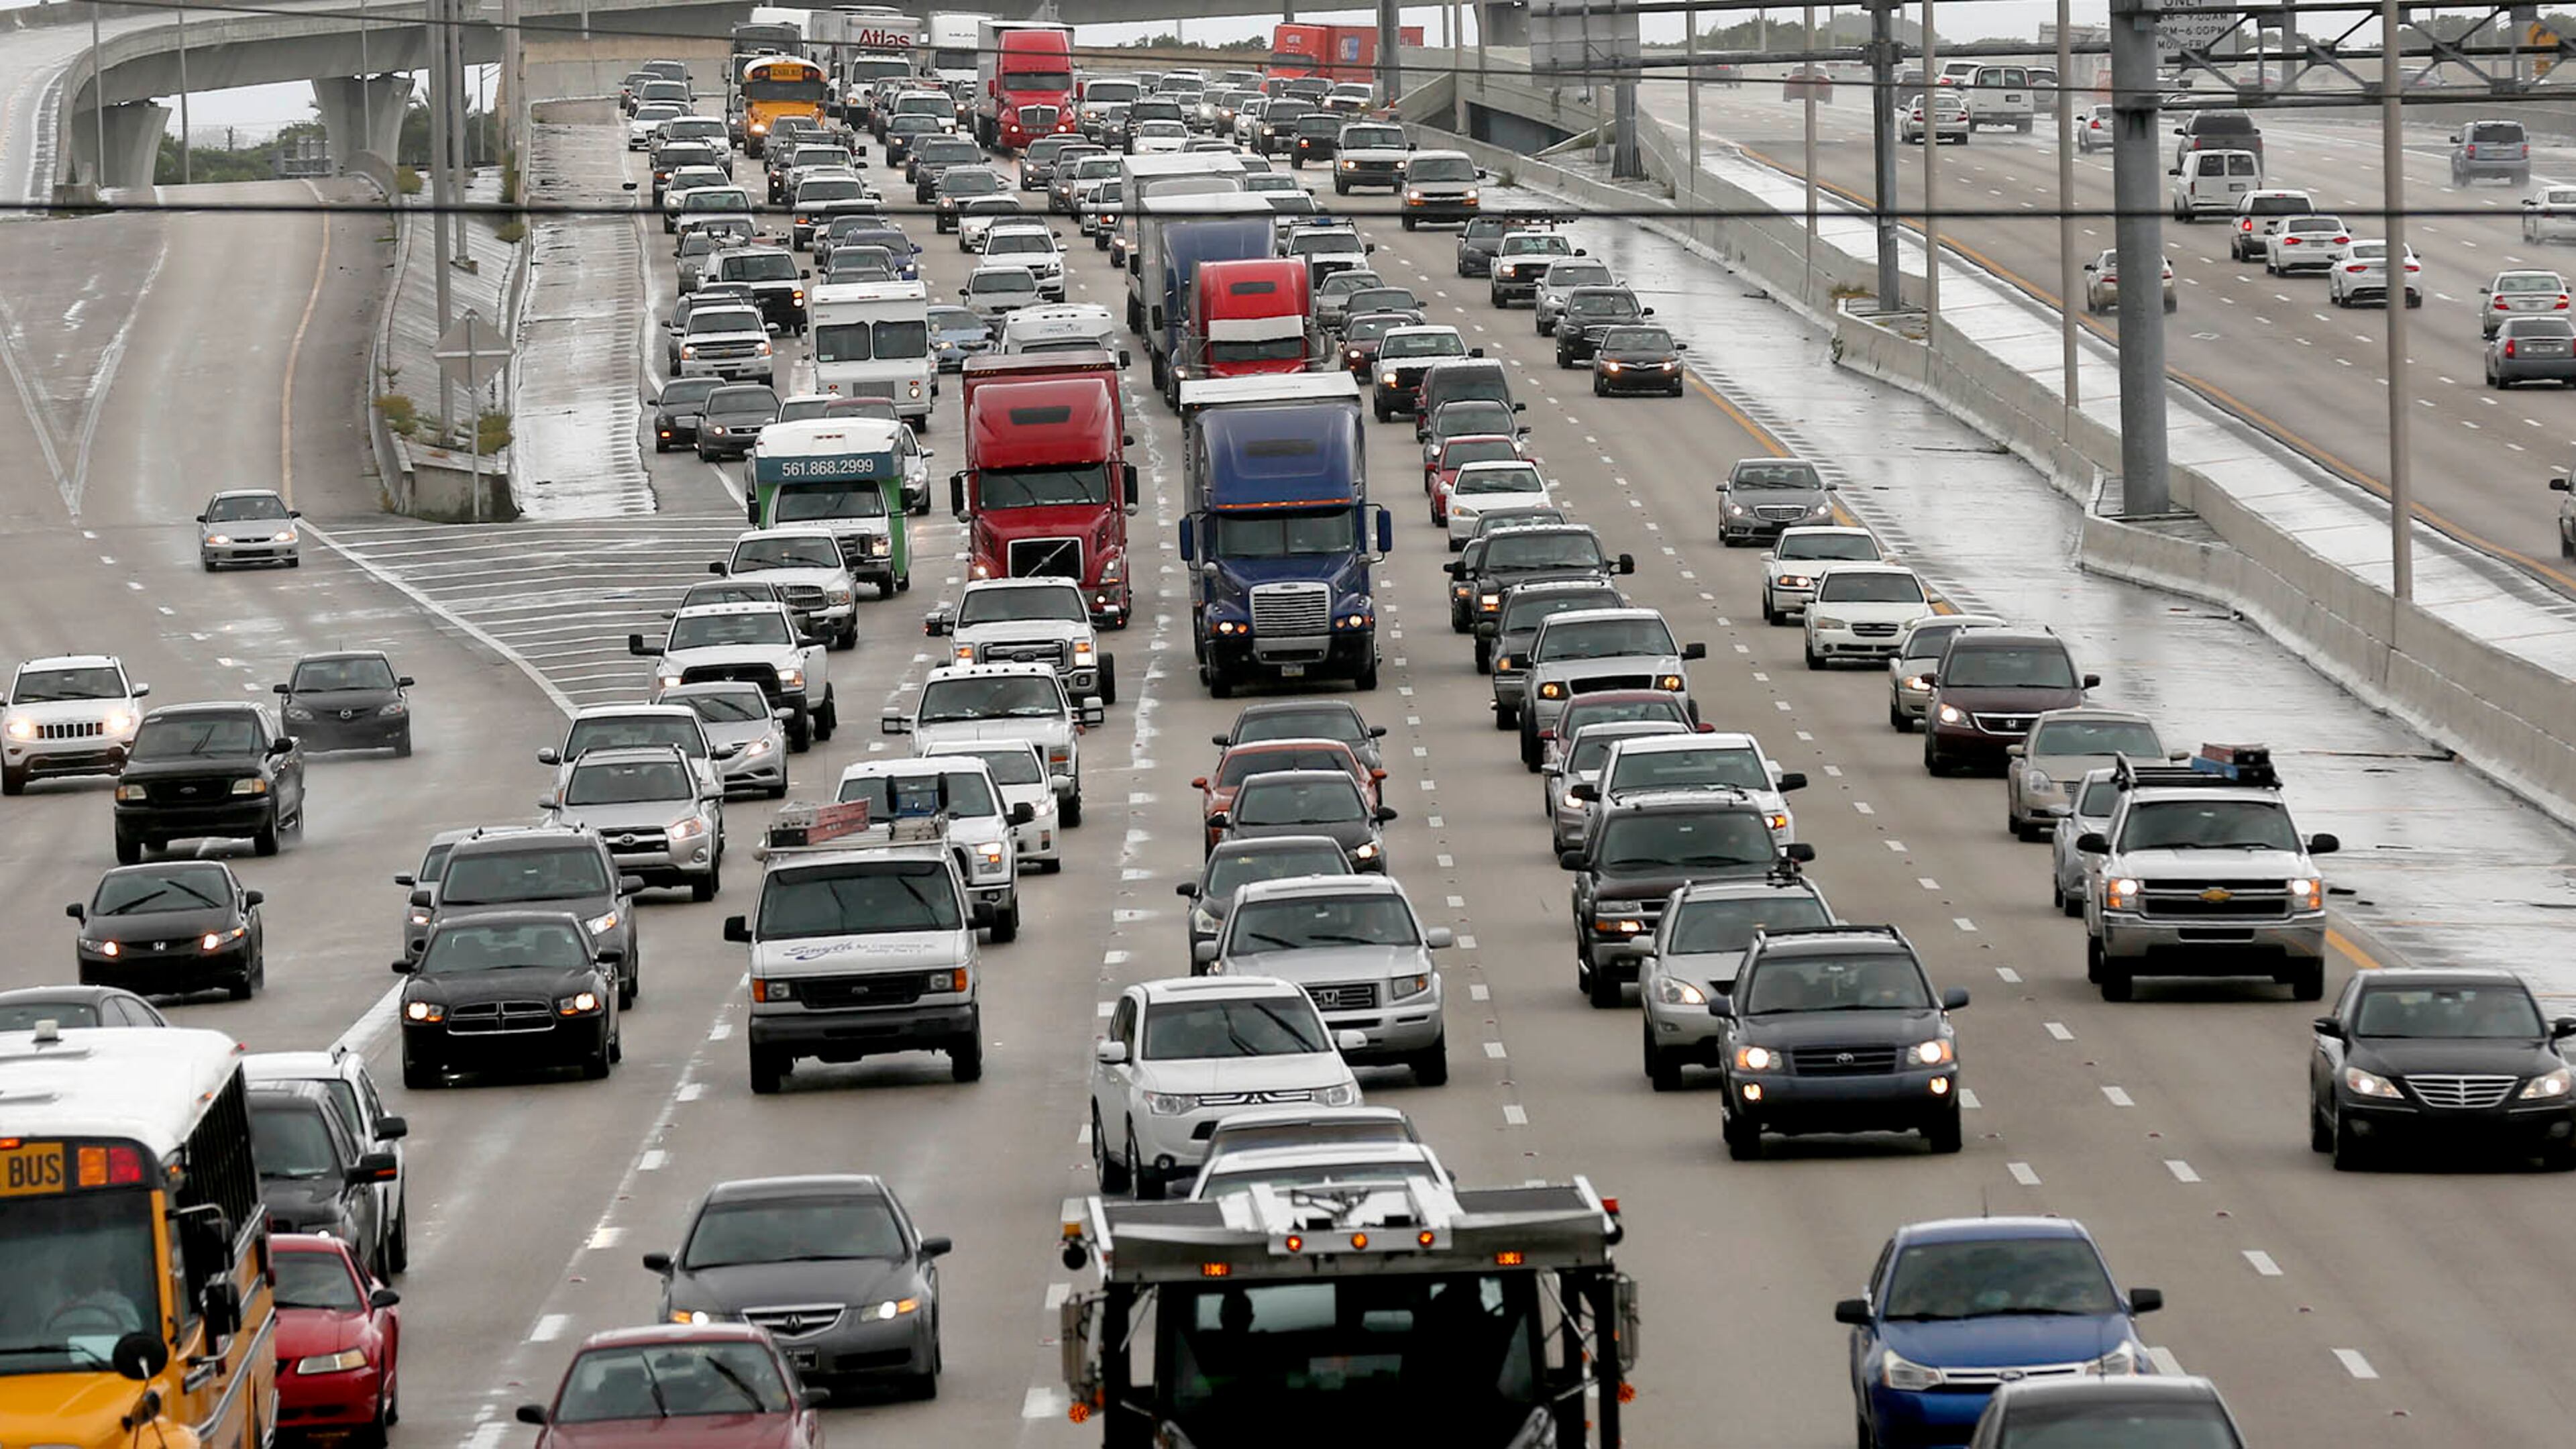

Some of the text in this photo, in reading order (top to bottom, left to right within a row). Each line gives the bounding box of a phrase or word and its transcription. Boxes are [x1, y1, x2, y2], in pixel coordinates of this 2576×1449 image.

[859, 29, 910, 47] Atlas
[782, 458, 873, 477] 561.868.2999
[9, 1153, 60, 1188] BUS
